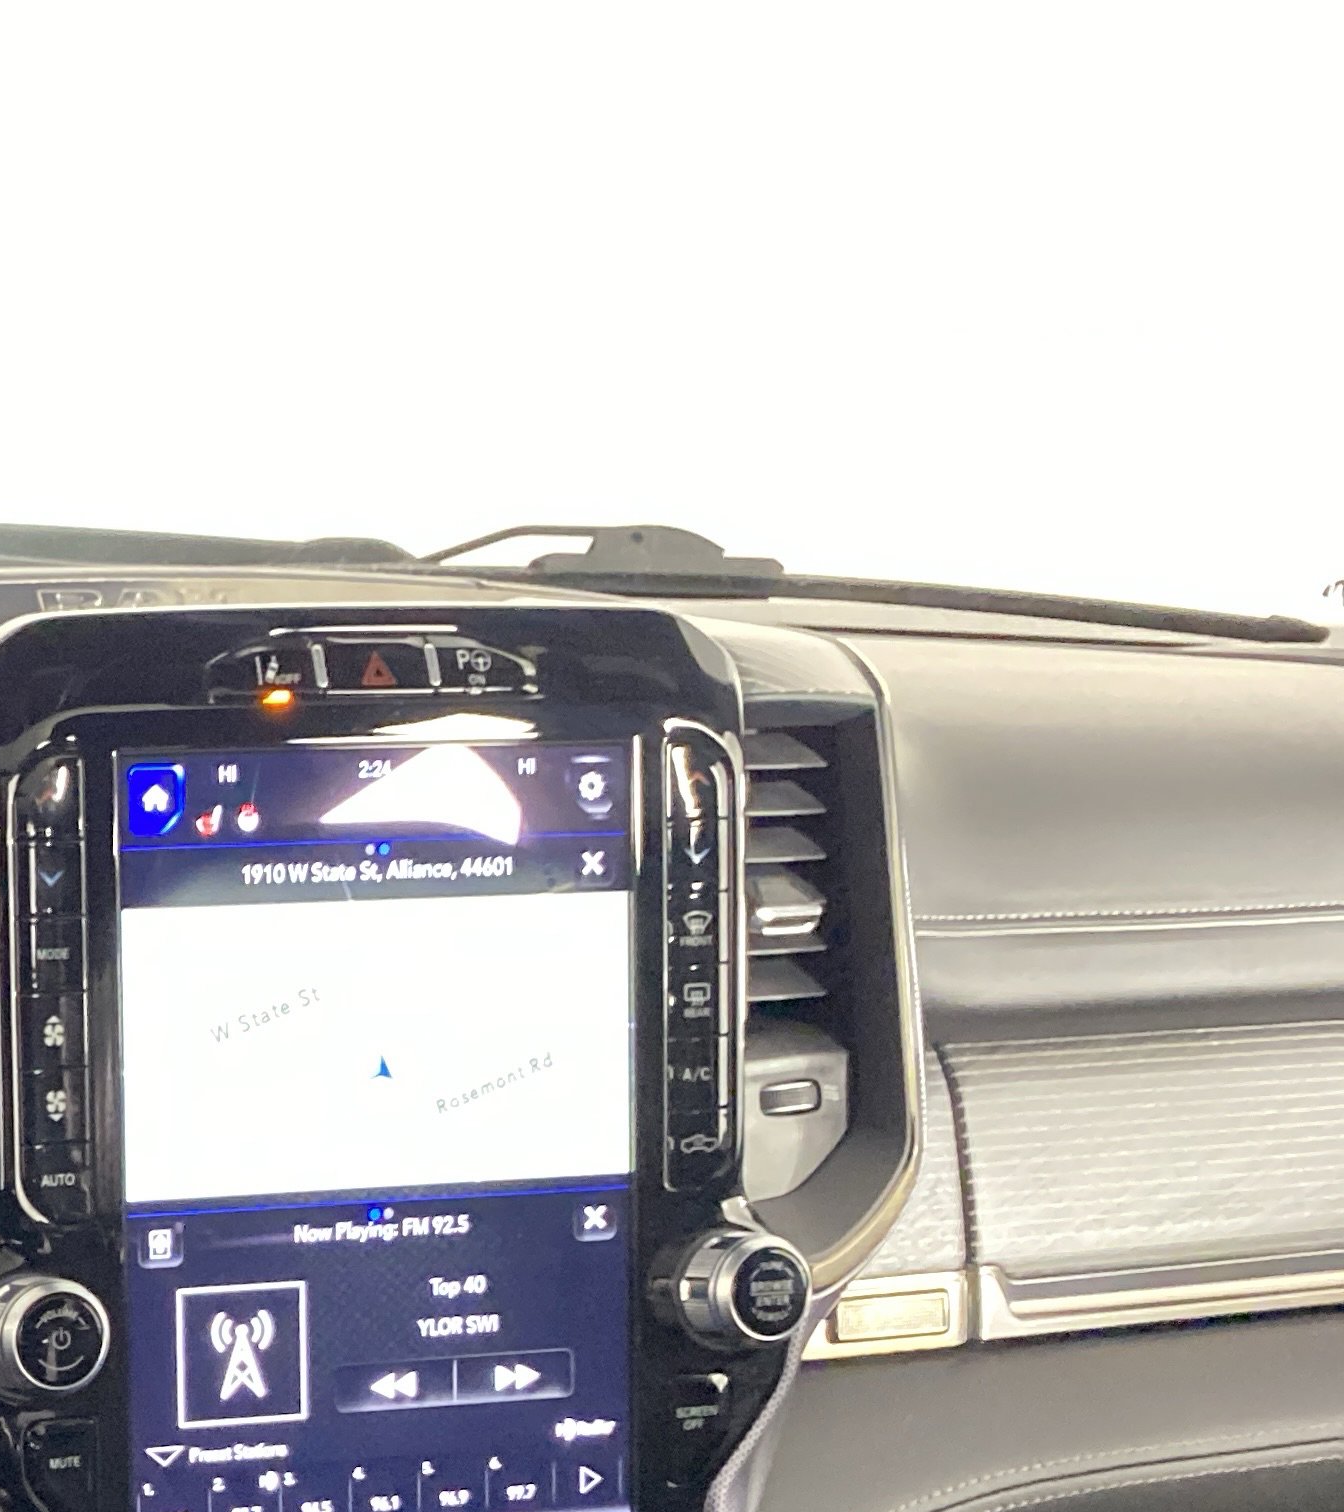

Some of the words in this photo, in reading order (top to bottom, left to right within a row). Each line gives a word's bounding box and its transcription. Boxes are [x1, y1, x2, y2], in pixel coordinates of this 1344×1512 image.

[218, 766, 236, 783] HI
[518, 758, 535, 775] HI
[242, 864, 286, 886] 1910
[287, 863, 311, 883] W
[312, 861, 357, 884] State
[359, 862, 384, 884] St,
[385, 858, 457, 882] Alliance,
[460, 856, 513, 879] 44601
[37, 949, 69, 960] MODE
[210, 1022, 231, 1043] W
[238, 1001, 291, 1033] State
[298, 987, 321, 1007] St
[436, 1067, 526, 1114] Rosemont
[529, 1052, 554, 1074] Rd
[682, 1067, 711, 1081] A/C
[41, 1175, 75, 1187] AUTO
[293, 1224, 333, 1243] Now
[336, 1220, 399, 1242] Playing:
[402, 1217, 430, 1237] FM
[432, 1214, 470, 1235] 92.5
[429, 1277, 461, 1299] Top
[463, 1274, 487, 1295] 40
[416, 1316, 463, 1338] YLOR
[49, 1456, 81, 1469] MUTE
